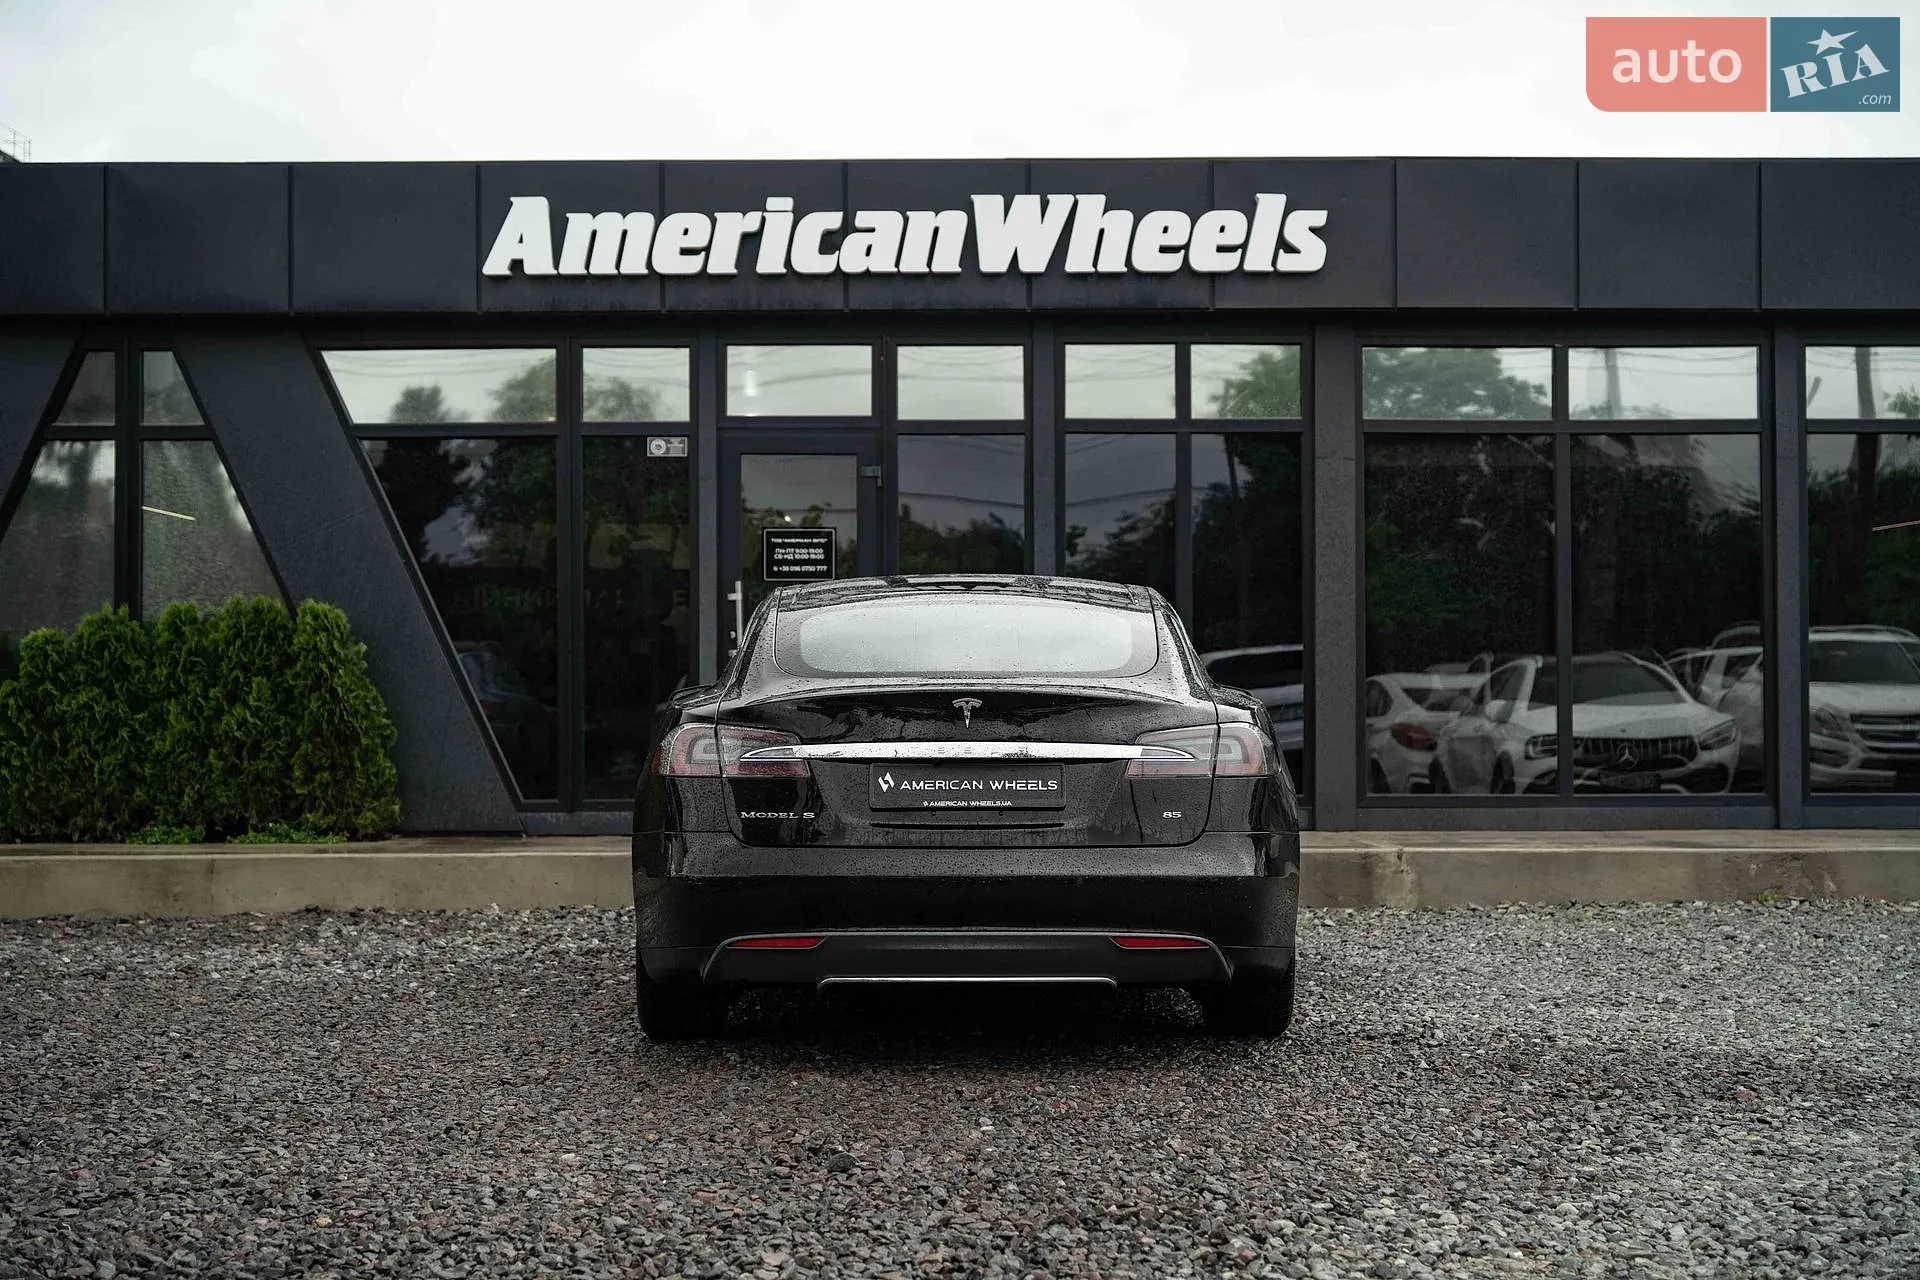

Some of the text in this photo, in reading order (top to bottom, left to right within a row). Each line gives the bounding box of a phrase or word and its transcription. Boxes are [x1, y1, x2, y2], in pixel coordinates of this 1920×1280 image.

[900, 780, 1058, 791] AMERICAN WHEELS
[1162, 811, 1182, 819] 85
